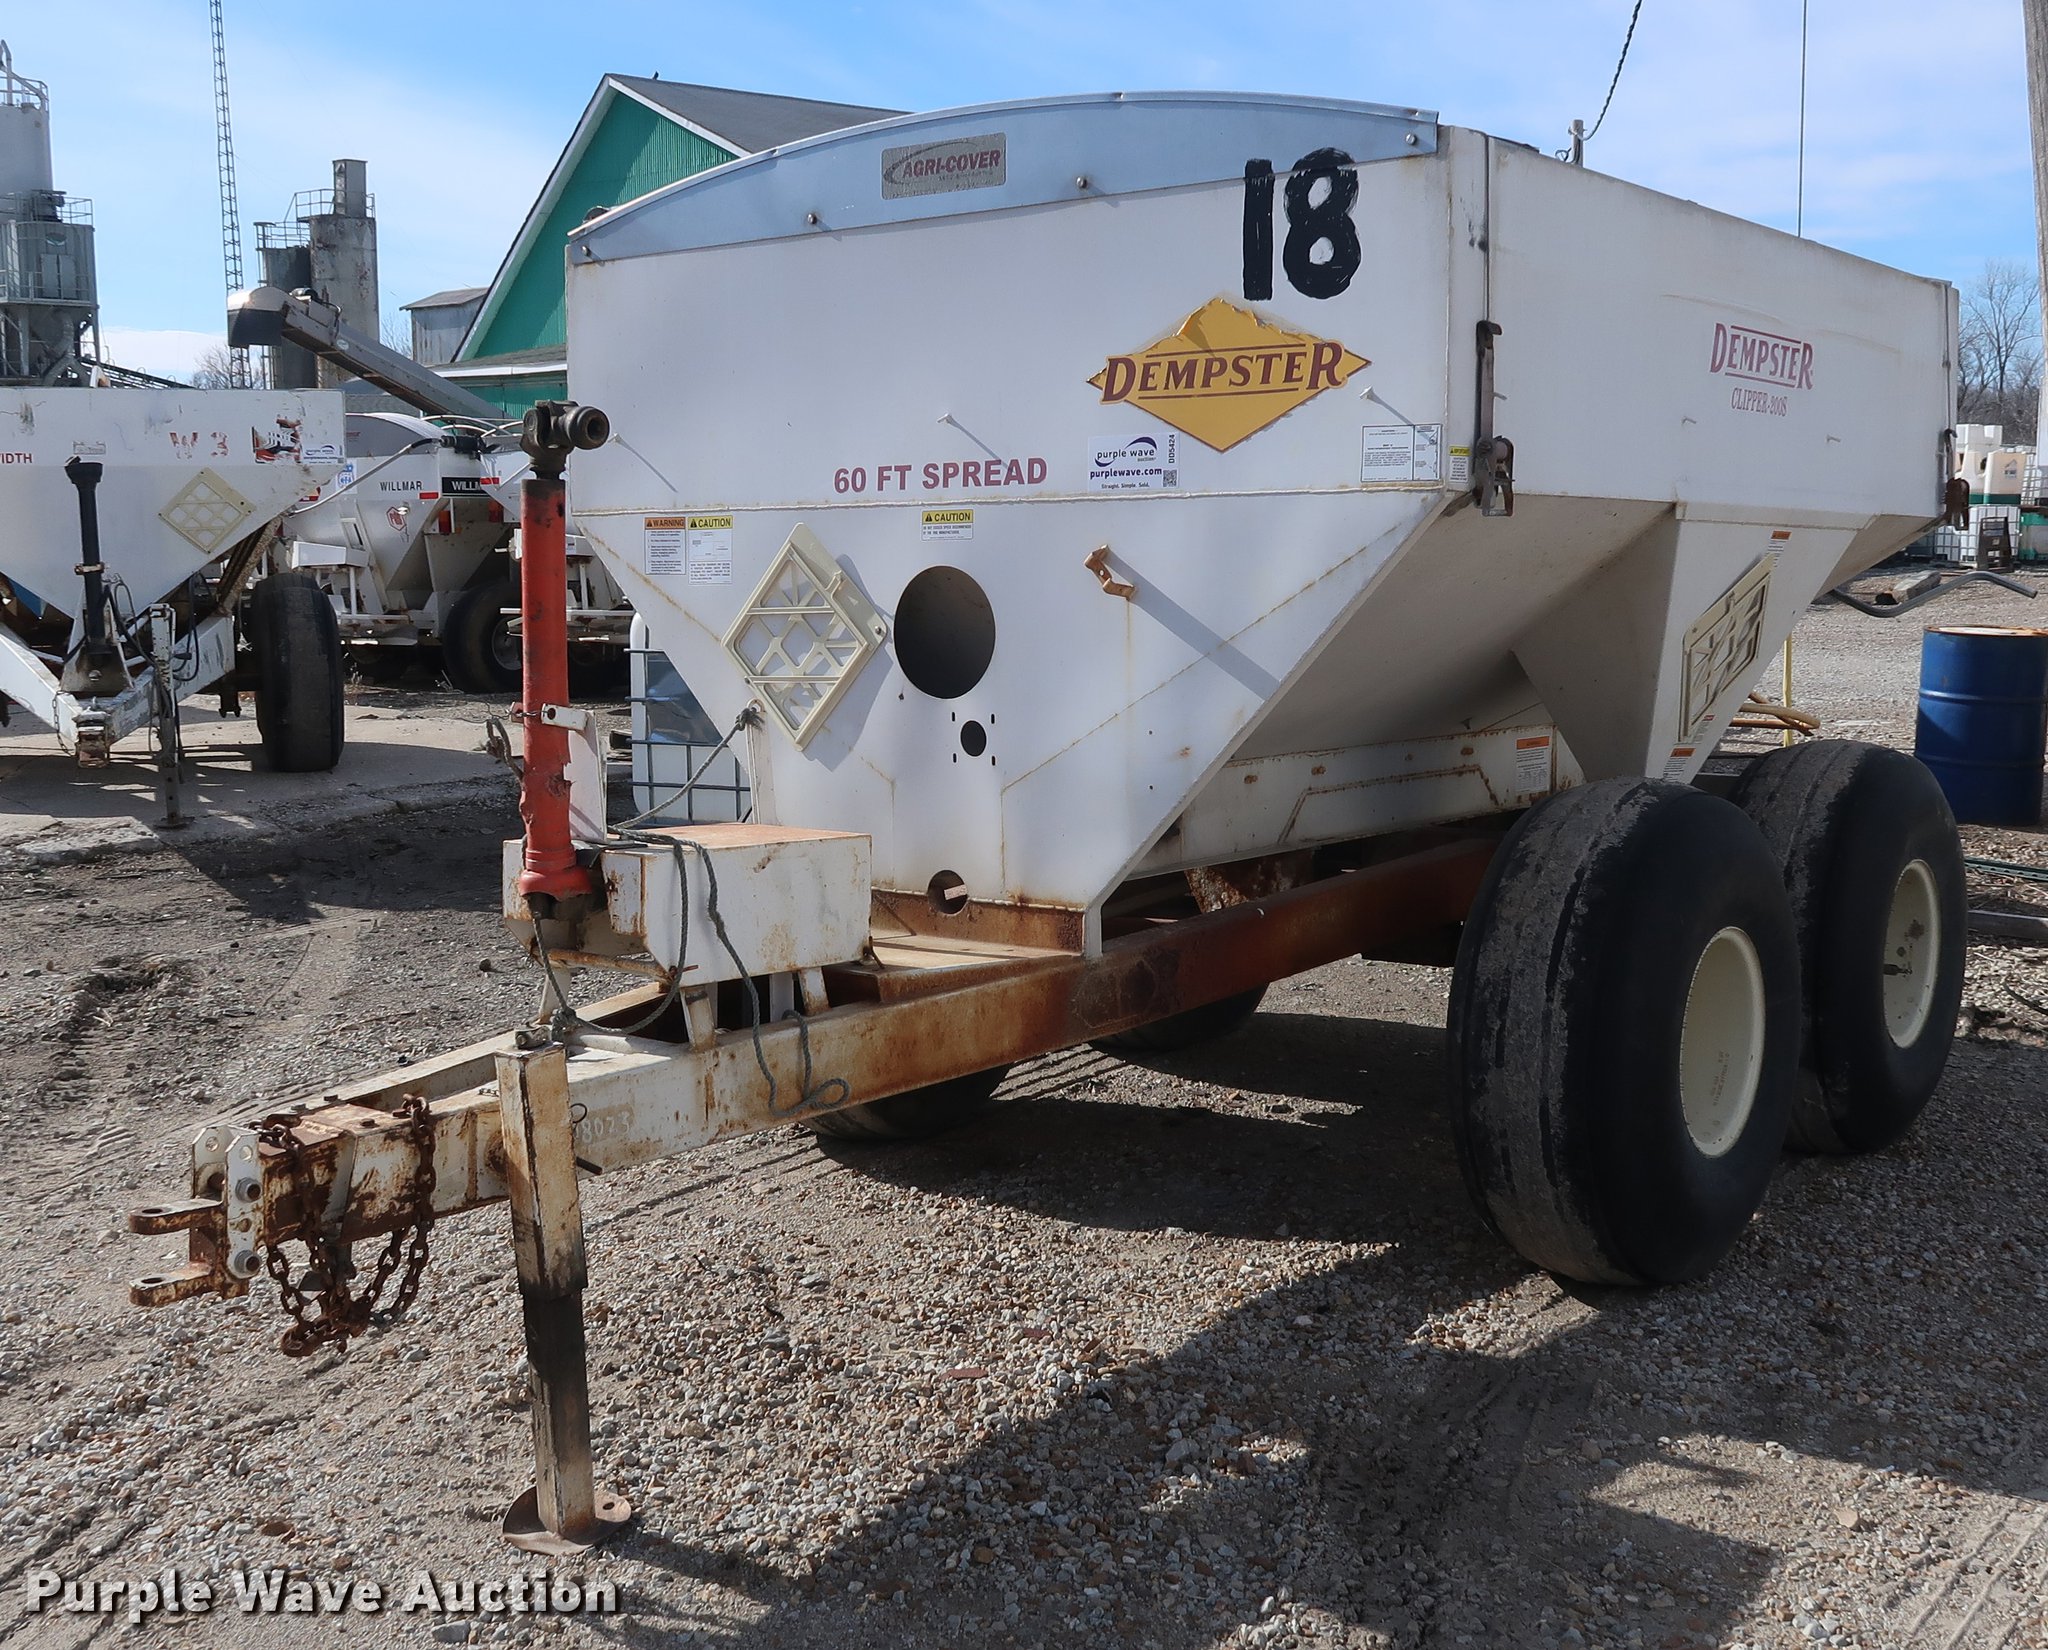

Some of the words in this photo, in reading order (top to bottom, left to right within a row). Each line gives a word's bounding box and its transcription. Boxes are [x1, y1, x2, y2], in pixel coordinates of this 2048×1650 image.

[903, 149, 1001, 178] AGRI-COVER
[1243, 147, 1362, 301] 18
[1710, 322, 1814, 391] DEMPSTER
[1102, 341, 1344, 402] DEMPSTER
[0, 453, 33, 464] IDTH
[1097, 449, 1127, 460] purple
[1130, 448, 1155, 457] wave
[834, 467, 867, 494] 60
[876, 464, 912, 491] FT
[922, 457, 1048, 490] SPREAD
[1089, 467, 1162, 480] purplewave.com
[379, 480, 423, 491] WILLMAR
[653, 518, 685, 527] WARNING
[697, 518, 731, 528] CAUTION
[934, 512, 971, 522] CAUTION
